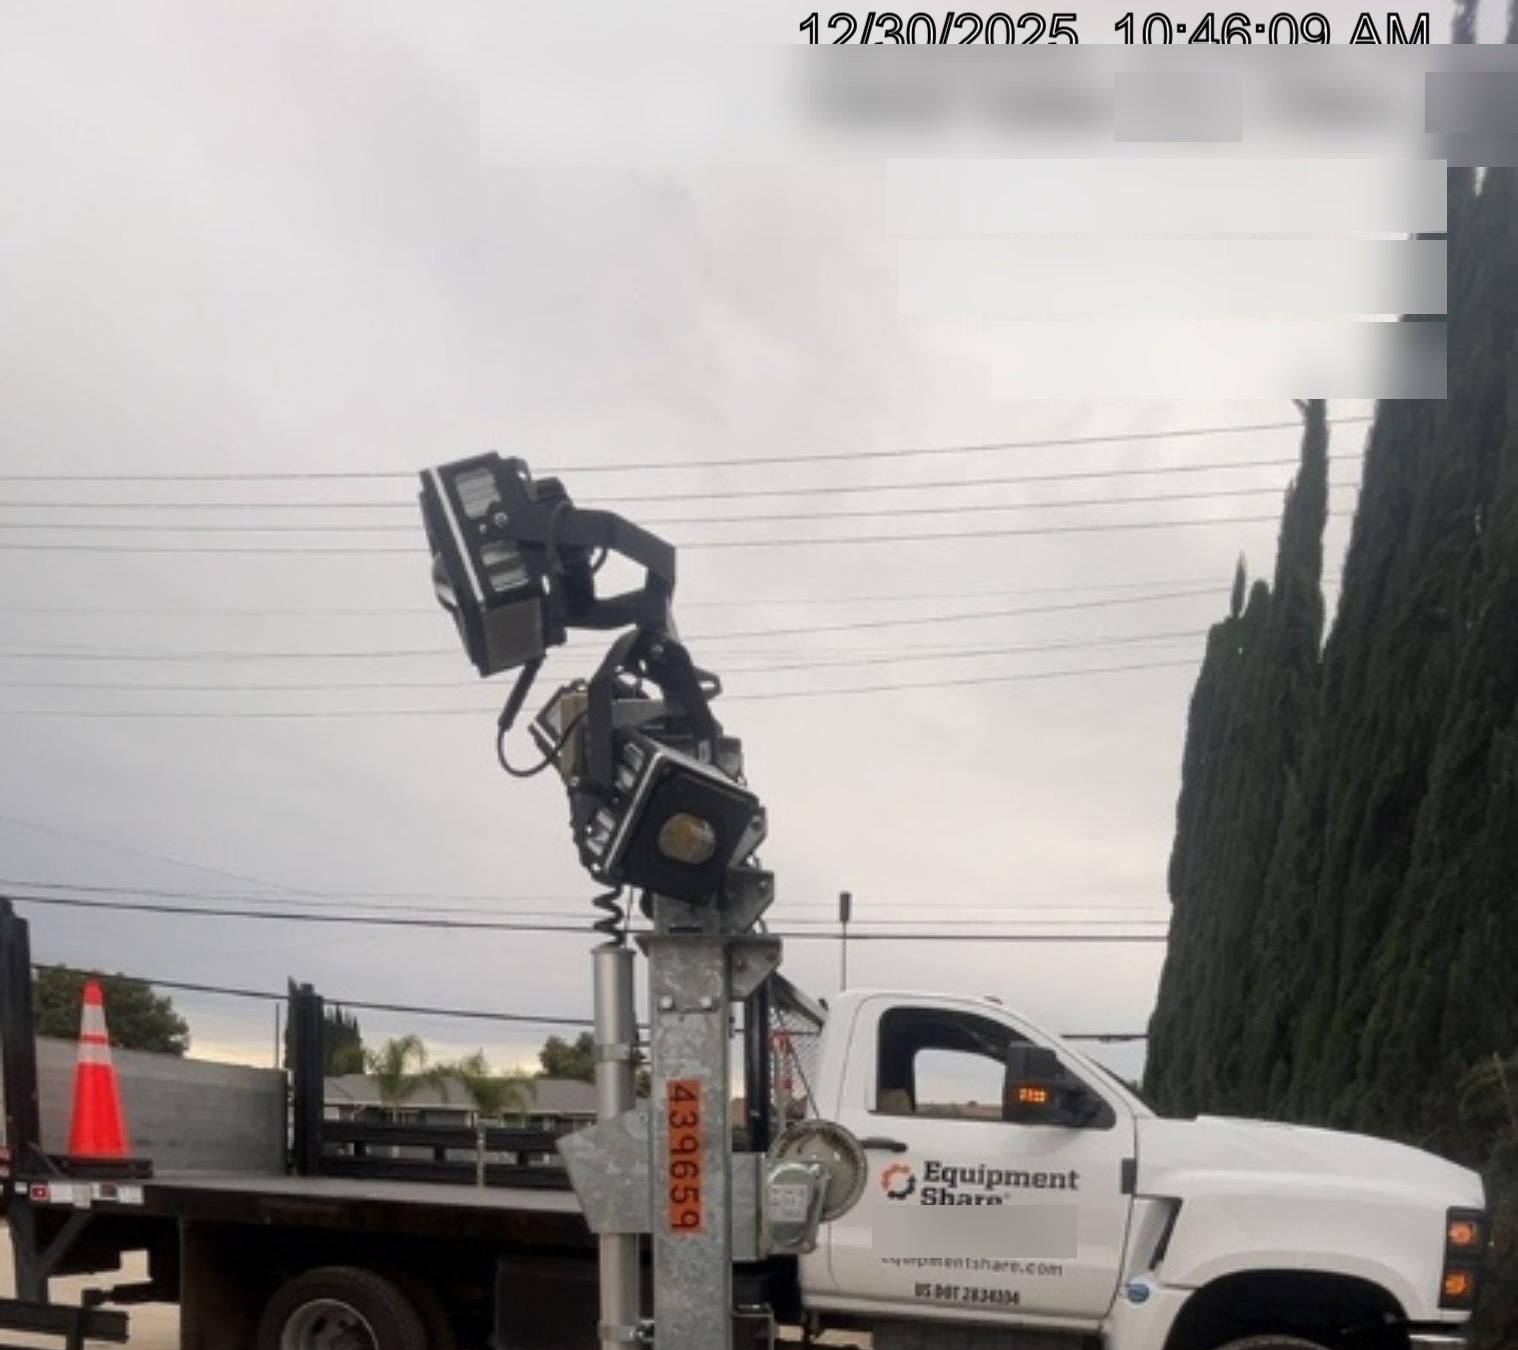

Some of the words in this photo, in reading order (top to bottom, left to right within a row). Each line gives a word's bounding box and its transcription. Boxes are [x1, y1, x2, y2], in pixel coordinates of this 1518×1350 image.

[668, 1084, 700, 1229] 439659
[923, 1160, 1080, 1190] Equipment
[920, 1186, 1003, 1205] Share
[914, 1282, 931, 1298] US
[935, 1283, 961, 1300] DOT
